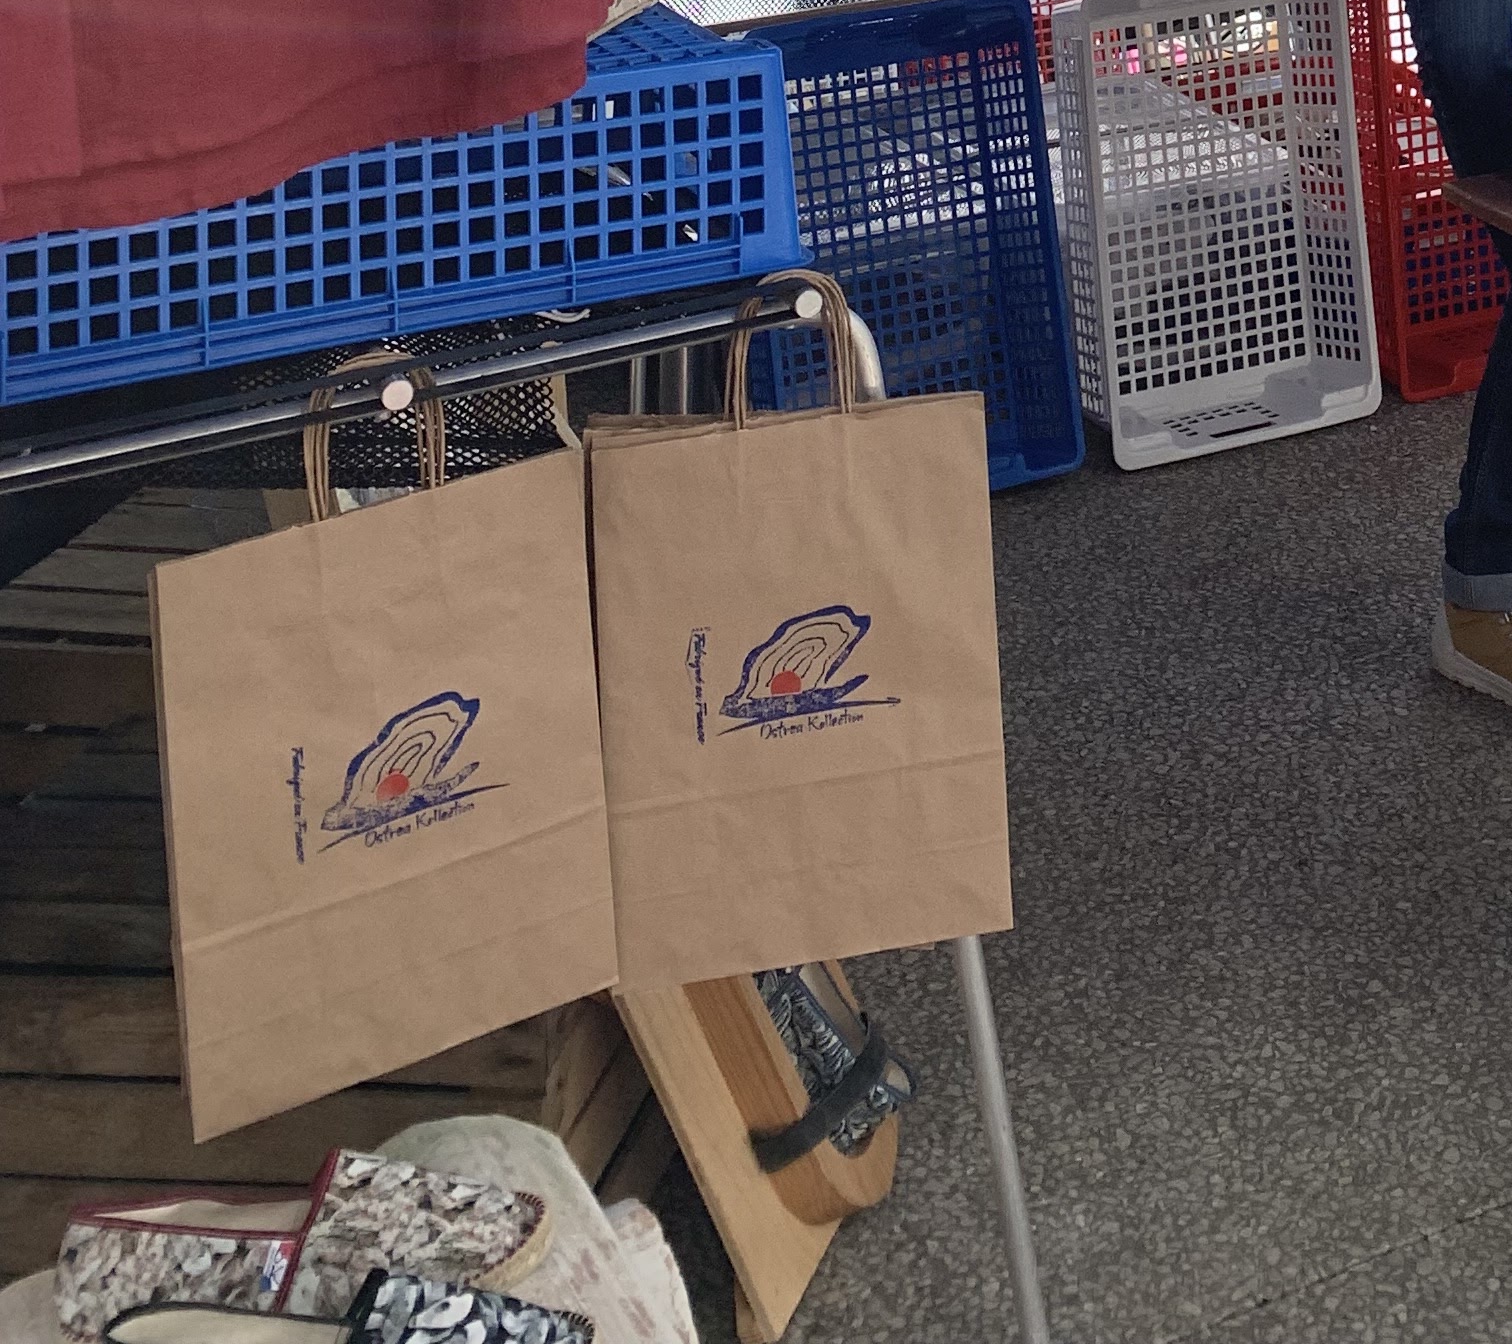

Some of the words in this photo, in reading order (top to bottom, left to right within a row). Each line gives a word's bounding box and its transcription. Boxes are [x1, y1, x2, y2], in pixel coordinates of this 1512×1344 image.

[760, 723, 804, 740] Ostrea
[808, 708, 865, 732] Kollection
[364, 823, 412, 849] Ostrea
[415, 800, 476, 830] Kollection
